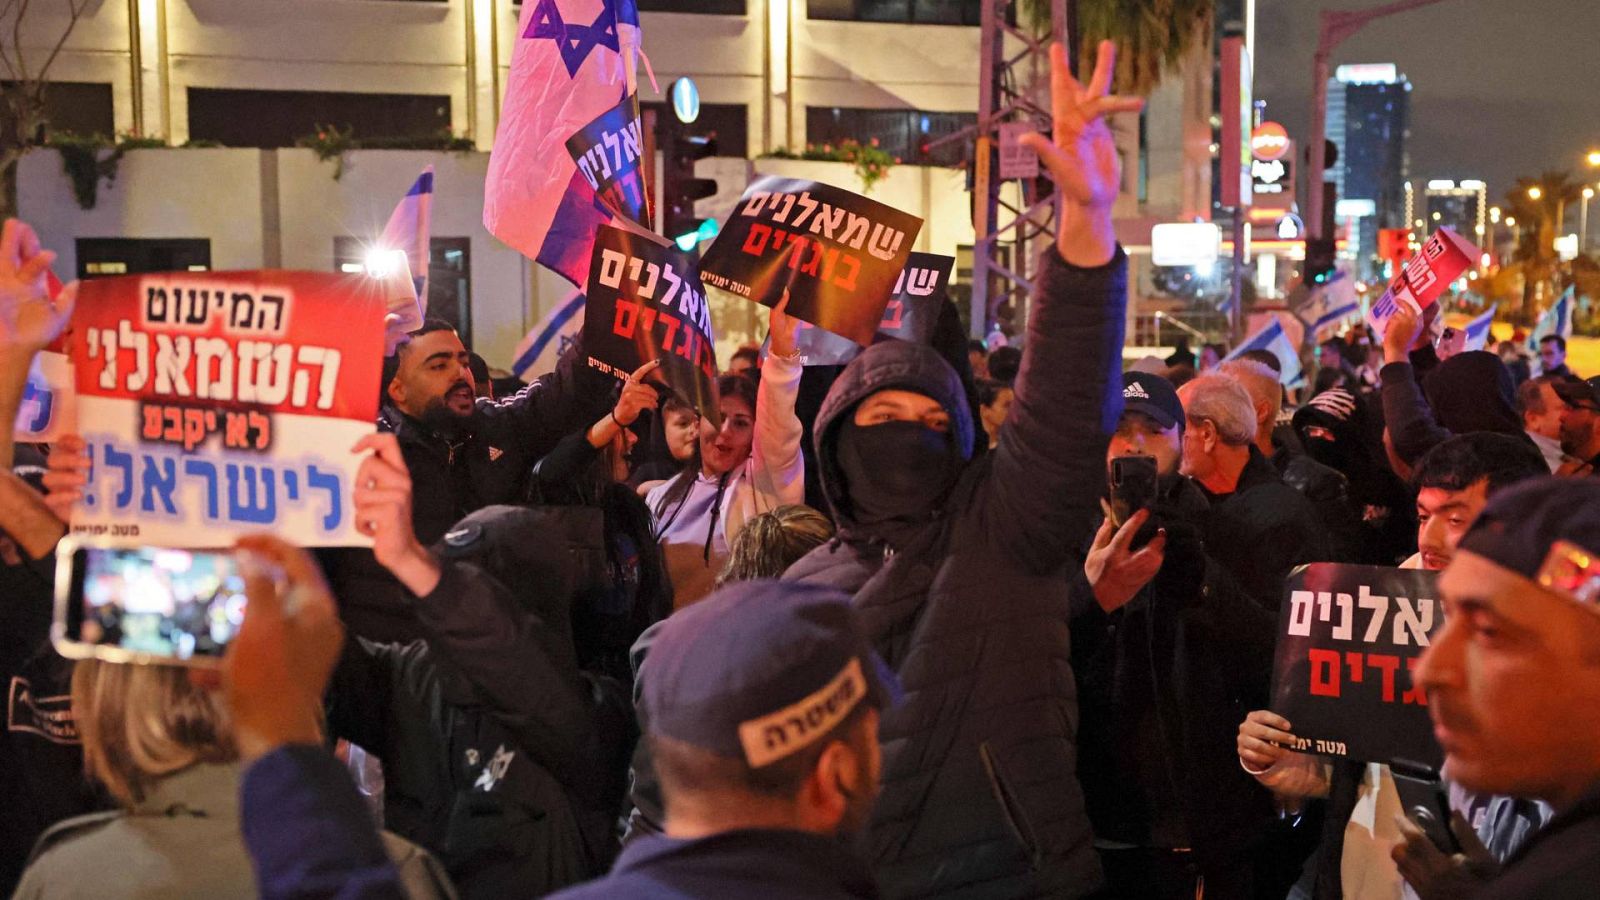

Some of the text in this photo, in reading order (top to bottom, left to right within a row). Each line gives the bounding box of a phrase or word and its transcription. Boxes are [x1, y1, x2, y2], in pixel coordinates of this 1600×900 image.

[577, 114, 643, 191] אלנים
[741, 191, 904, 261] שמאלנים
[700, 270, 751, 297] מטה ימניים
[741, 223, 862, 292] בוגדים
[146, 286, 285, 331] המיעוט
[86, 320, 342, 410] השמאלני
[588, 356, 631, 381] מטה ימניים
[142, 405, 271, 450] לא יקבע
[86, 442, 342, 531] לישראל!
[111, 525, 139, 536] מטה
[1287, 585, 1434, 647] אלנים
[1309, 648, 1428, 706] גדים
[763, 676, 855, 751] משטרה
[1316, 740, 1346, 755] מטה
